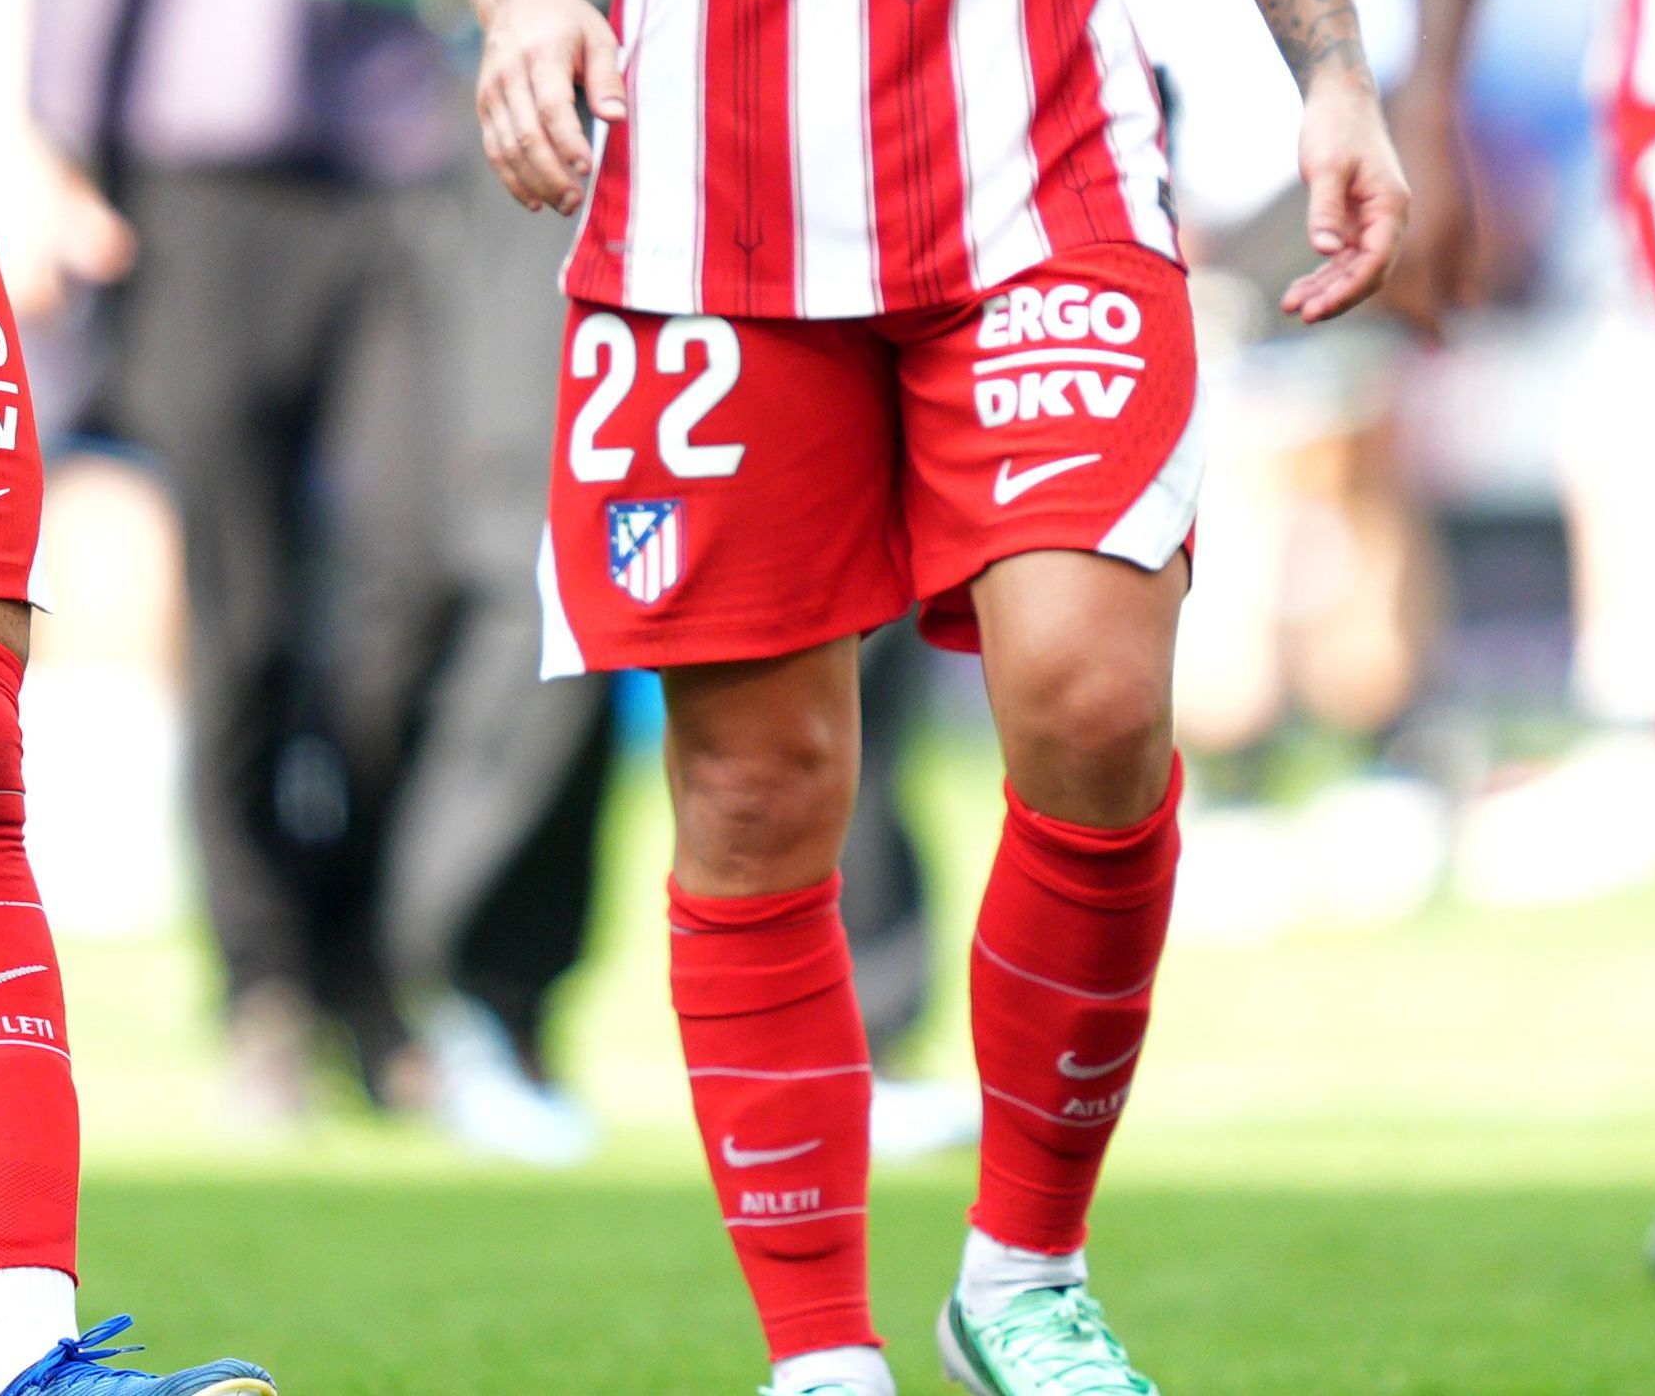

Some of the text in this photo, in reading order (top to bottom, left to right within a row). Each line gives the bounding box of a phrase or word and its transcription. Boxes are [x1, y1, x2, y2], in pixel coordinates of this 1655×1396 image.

[976, 283, 1142, 349] ERGO
[569, 311, 747, 484] 22
[974, 370, 1137, 429] DKV
